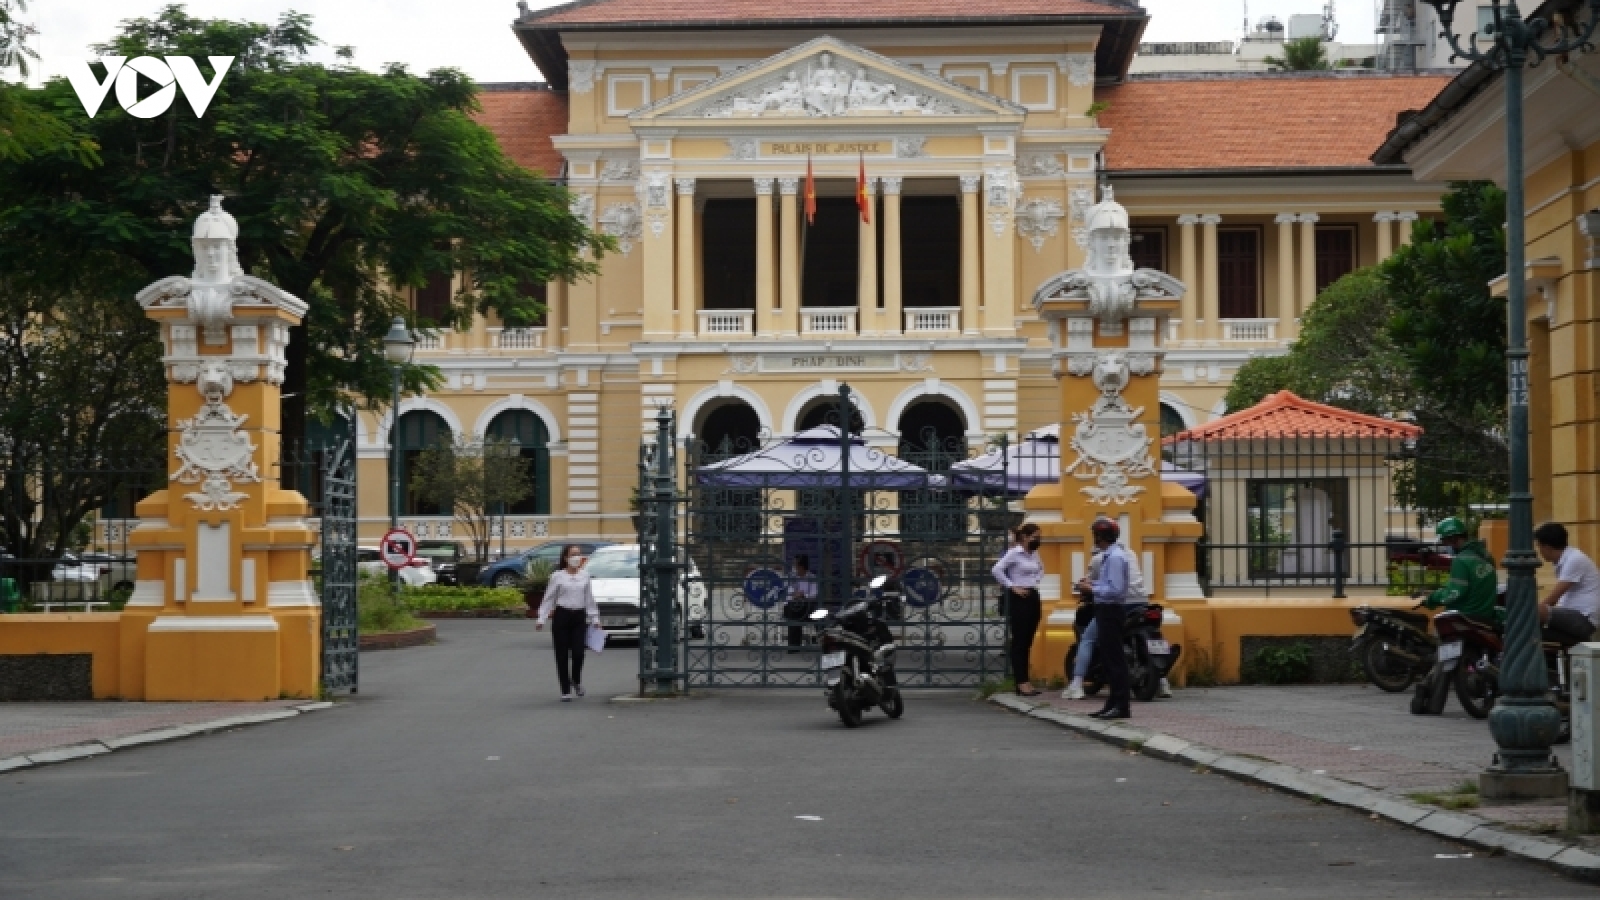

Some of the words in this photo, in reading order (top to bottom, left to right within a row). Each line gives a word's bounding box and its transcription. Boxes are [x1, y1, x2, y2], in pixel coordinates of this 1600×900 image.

[771, 143, 811, 155] PALAIS
[815, 143, 830, 154] DE
[834, 143, 880, 153] JUSTICE
